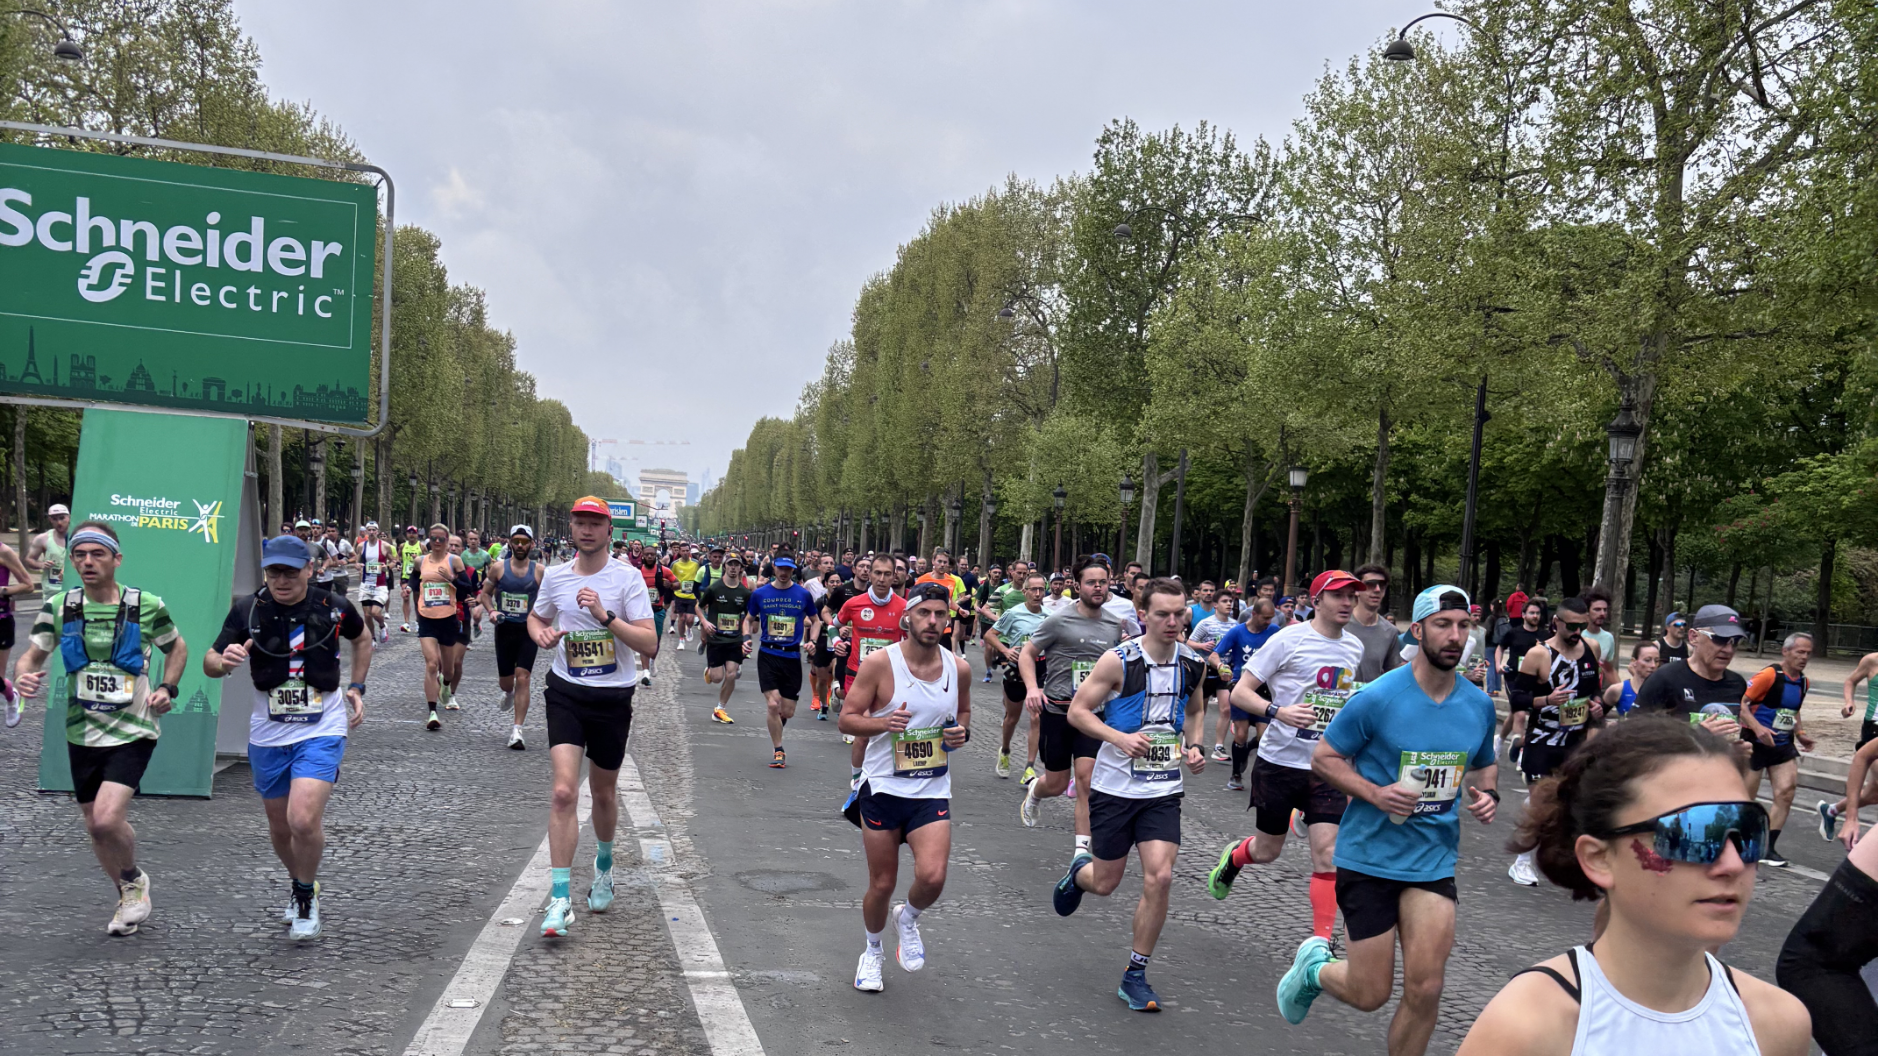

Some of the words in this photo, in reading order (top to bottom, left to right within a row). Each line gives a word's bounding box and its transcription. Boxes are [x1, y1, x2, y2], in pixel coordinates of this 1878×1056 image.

[0, 187, 343, 279] Schneider
[110, 493, 181, 509] Schneider
[139, 507, 178, 516] Electric
[89, 512, 140, 523] MARATHON
[138, 516, 189, 531] PARIS
[86, 674, 117, 693] 6153
[907, 727, 941, 736] Schneider
[904, 741, 933, 759] 4690
[1420, 751, 1460, 761] Schneider
[1423, 804, 1442, 812] asics
